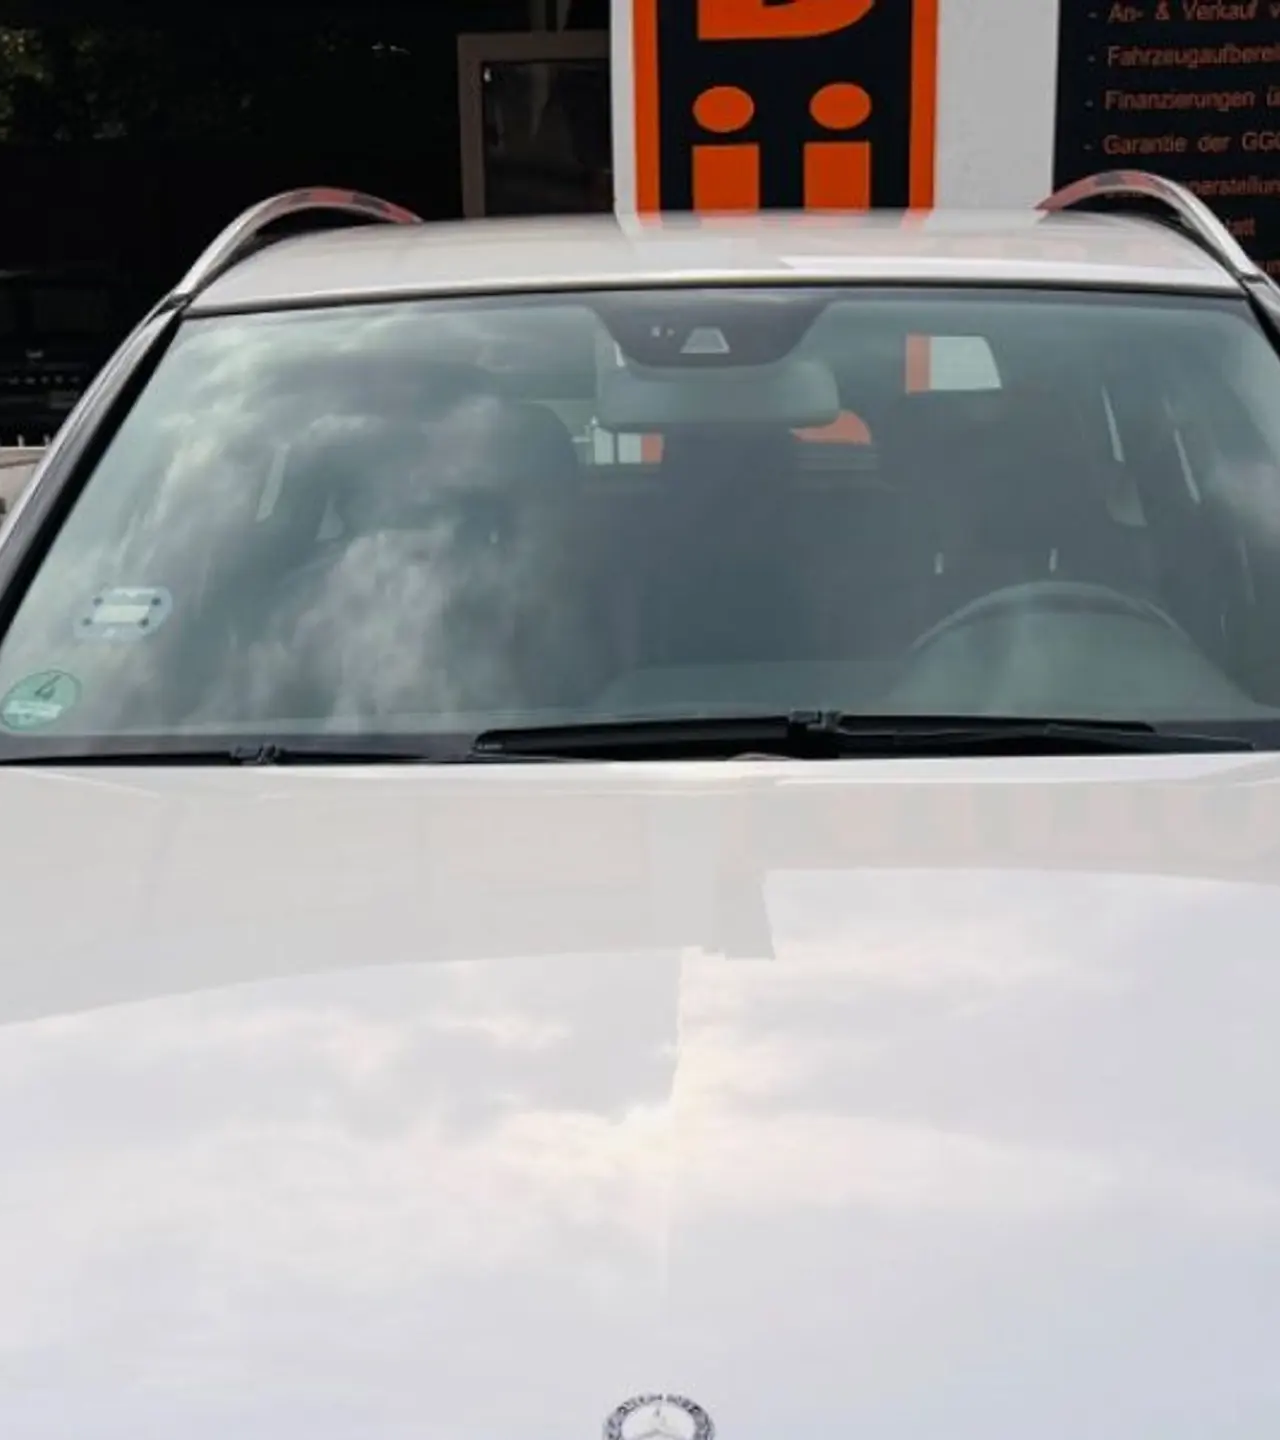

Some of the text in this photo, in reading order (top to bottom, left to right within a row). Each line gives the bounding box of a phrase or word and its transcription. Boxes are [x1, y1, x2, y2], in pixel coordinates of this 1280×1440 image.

[1154, 1, 1170, 20] &
[1182, 0, 1258, 21] Verkauf
[1104, 89, 1256, 111] Finanzierungen
[1103, 133, 1189, 154] Garantie
[1198, 134, 1231, 152] der
